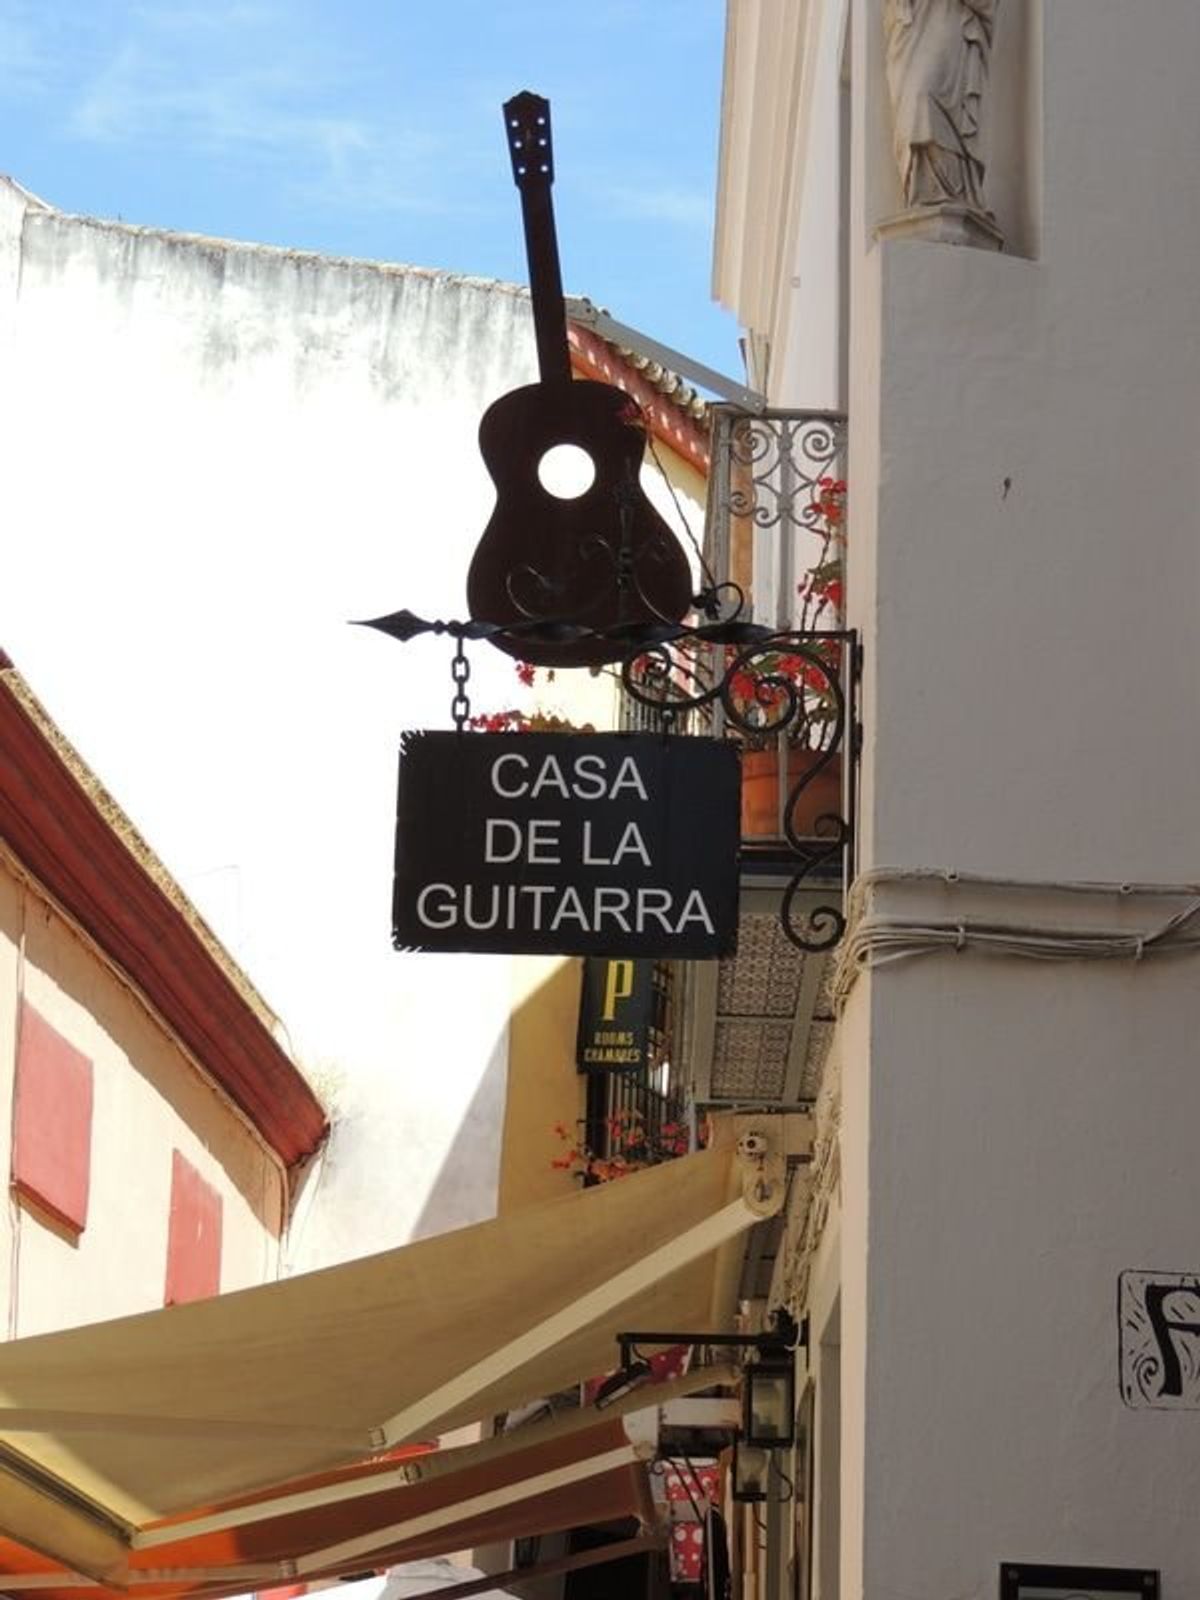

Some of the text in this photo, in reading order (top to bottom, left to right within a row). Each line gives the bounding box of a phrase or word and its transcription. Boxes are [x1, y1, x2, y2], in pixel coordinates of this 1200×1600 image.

[491, 753, 649, 800] CASA
[485, 818, 652, 866] DE LA
[416, 883, 716, 935] GUITARRA
[603, 960, 634, 1020] P
